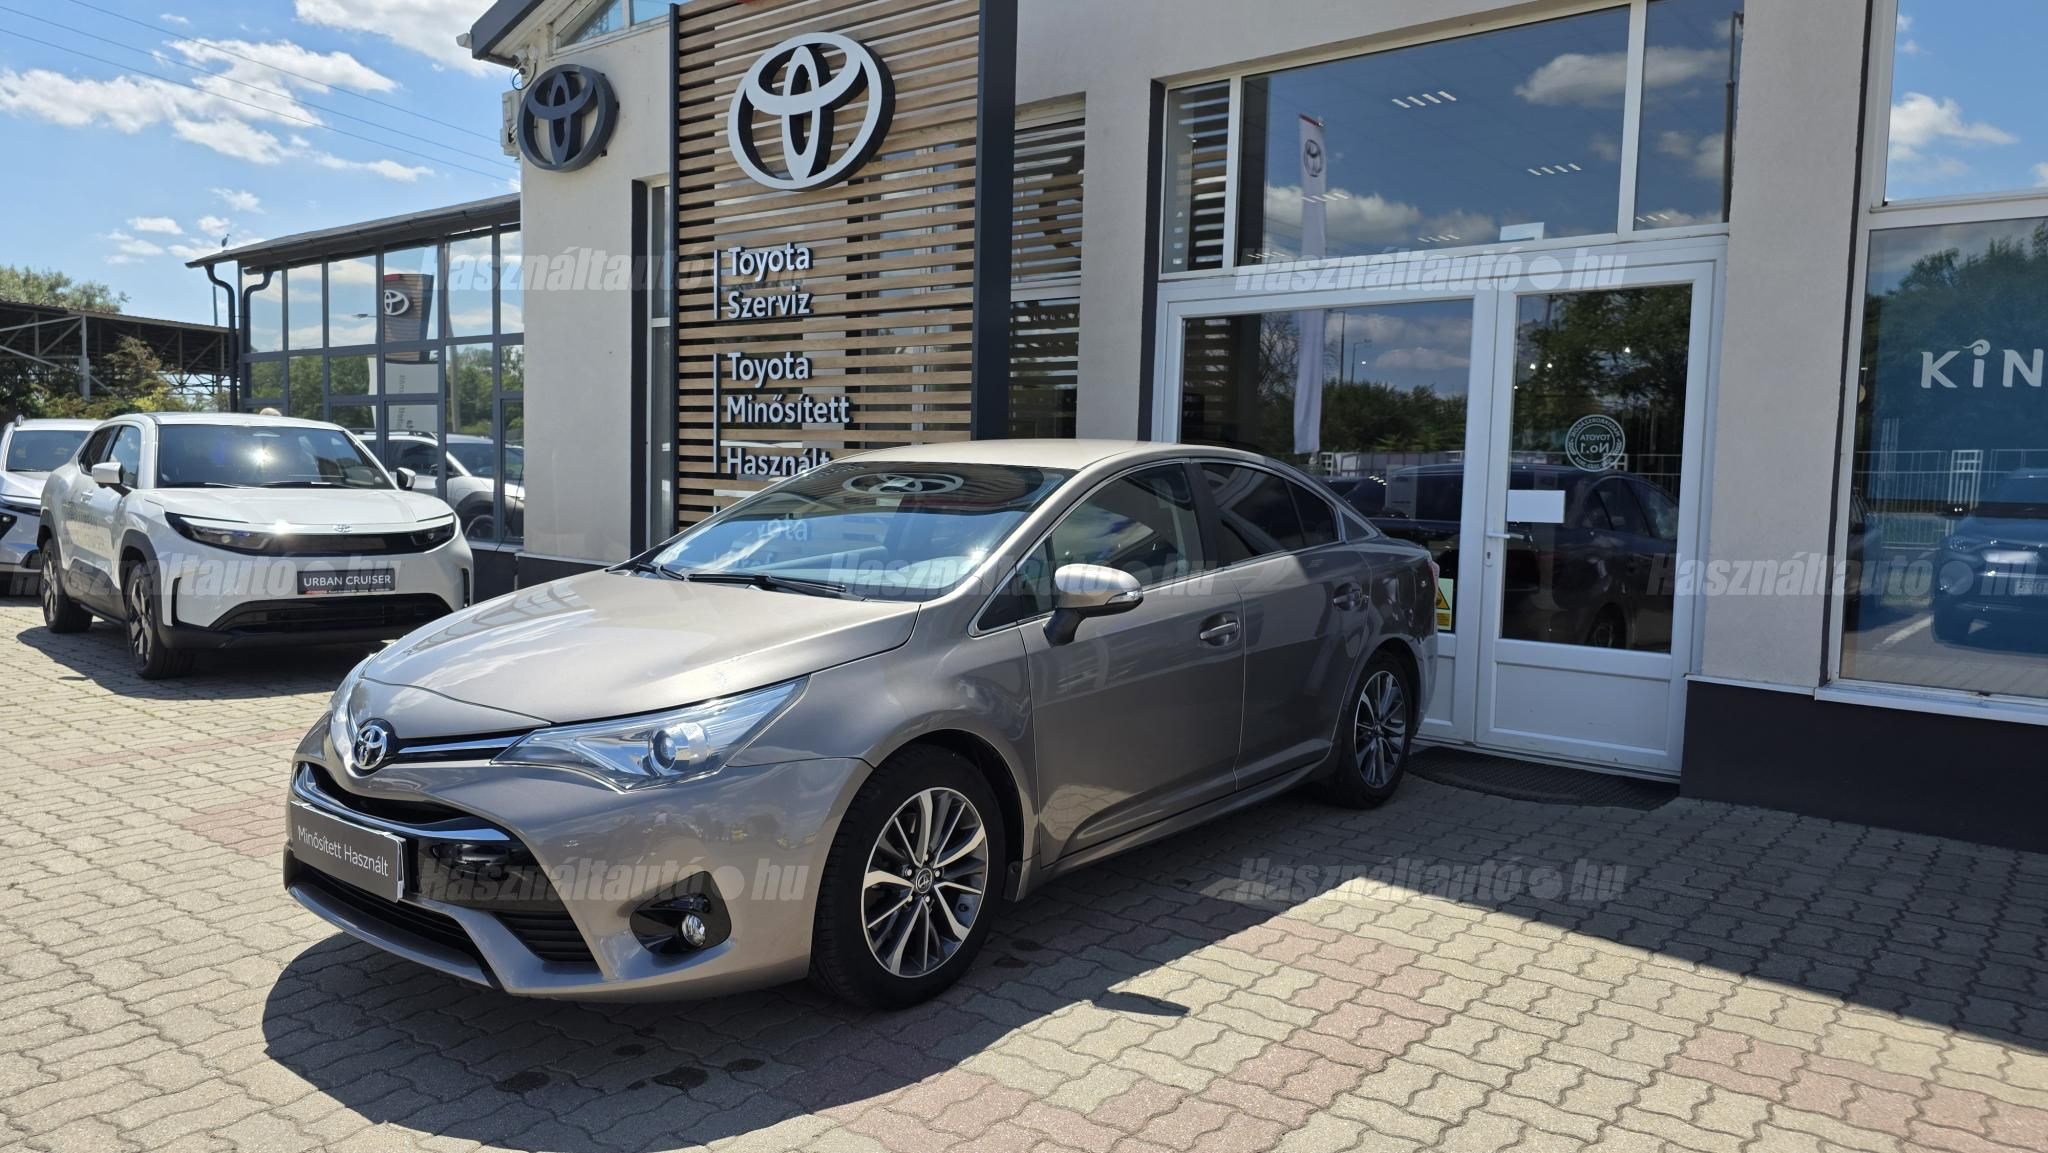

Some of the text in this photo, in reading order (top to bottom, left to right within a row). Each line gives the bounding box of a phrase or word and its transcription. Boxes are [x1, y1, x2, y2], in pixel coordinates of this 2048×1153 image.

[728, 242, 809, 282] Toyota
[728, 285, 809, 319] Szerviz
[728, 351, 809, 388] Toyota
[727, 394, 849, 423] Minősített
[727, 448, 829, 477] Használt
[304, 575, 391, 587] URBAN CRUISER
[298, 825, 388, 877] Minősített Használt
